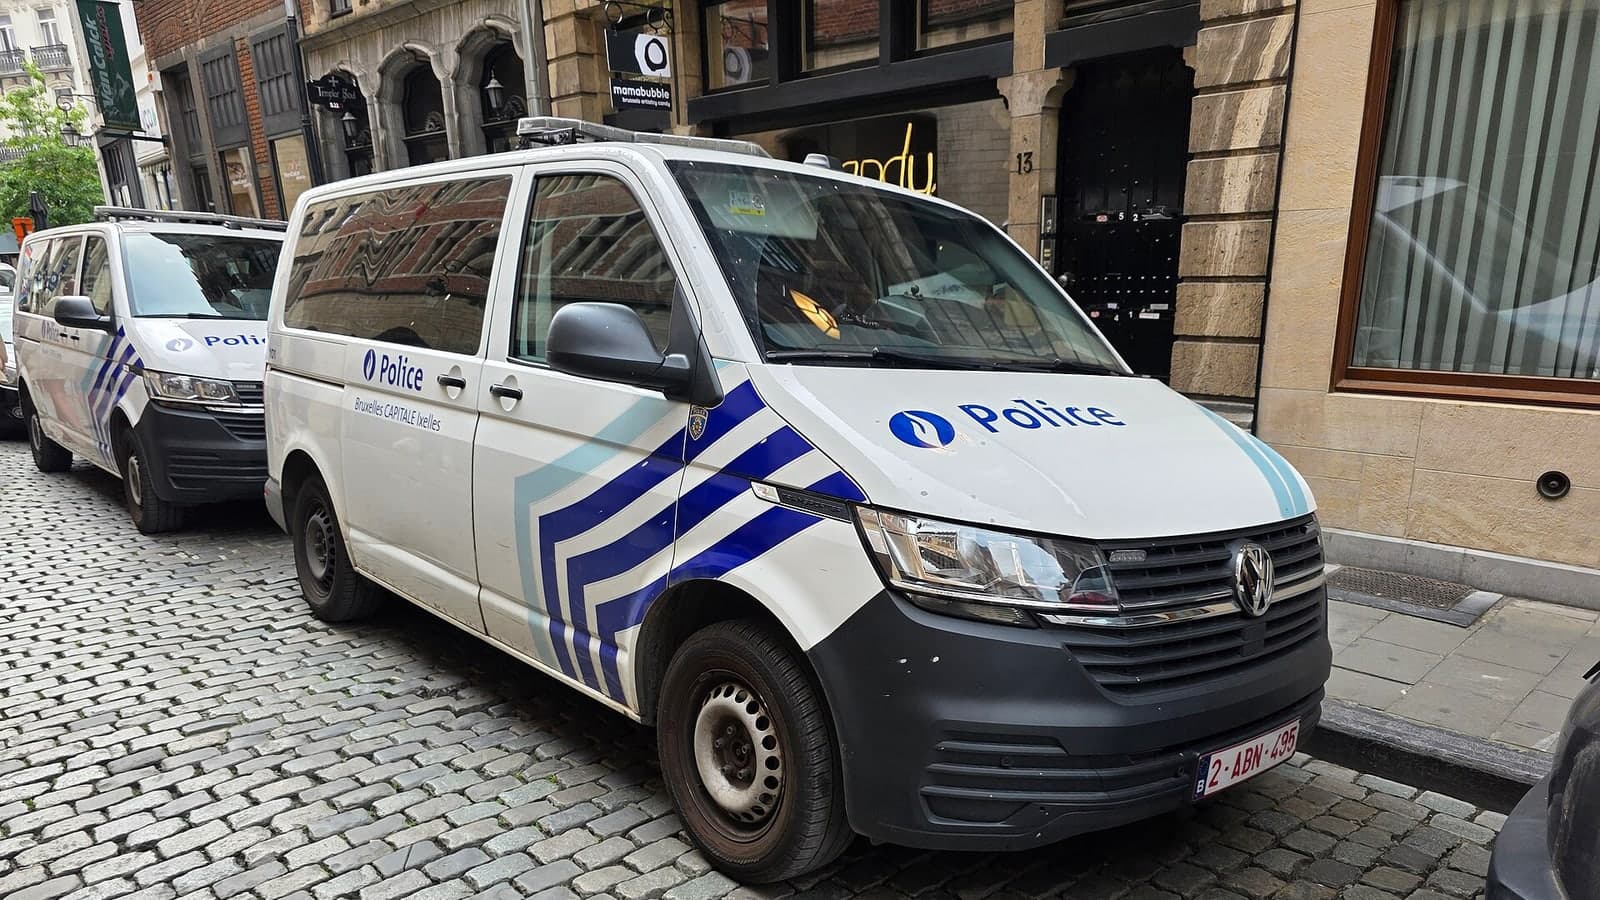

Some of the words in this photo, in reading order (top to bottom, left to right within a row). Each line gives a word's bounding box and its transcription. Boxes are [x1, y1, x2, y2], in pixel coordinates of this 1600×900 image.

[612, 85, 670, 99] mamabubble
[1016, 151, 1033, 174] 13
[1118, 211, 1125, 220] 5
[1132, 213, 1139, 222] 2
[1113, 314, 1119, 322] 4
[379, 354, 423, 391] Police
[354, 397, 383, 416] Bruxelles
[384, 403, 416, 425] CAPITALE
[416, 411, 441, 432] Ixelles
[958, 399, 1127, 433] Police
[1196, 779, 1205, 793] B
